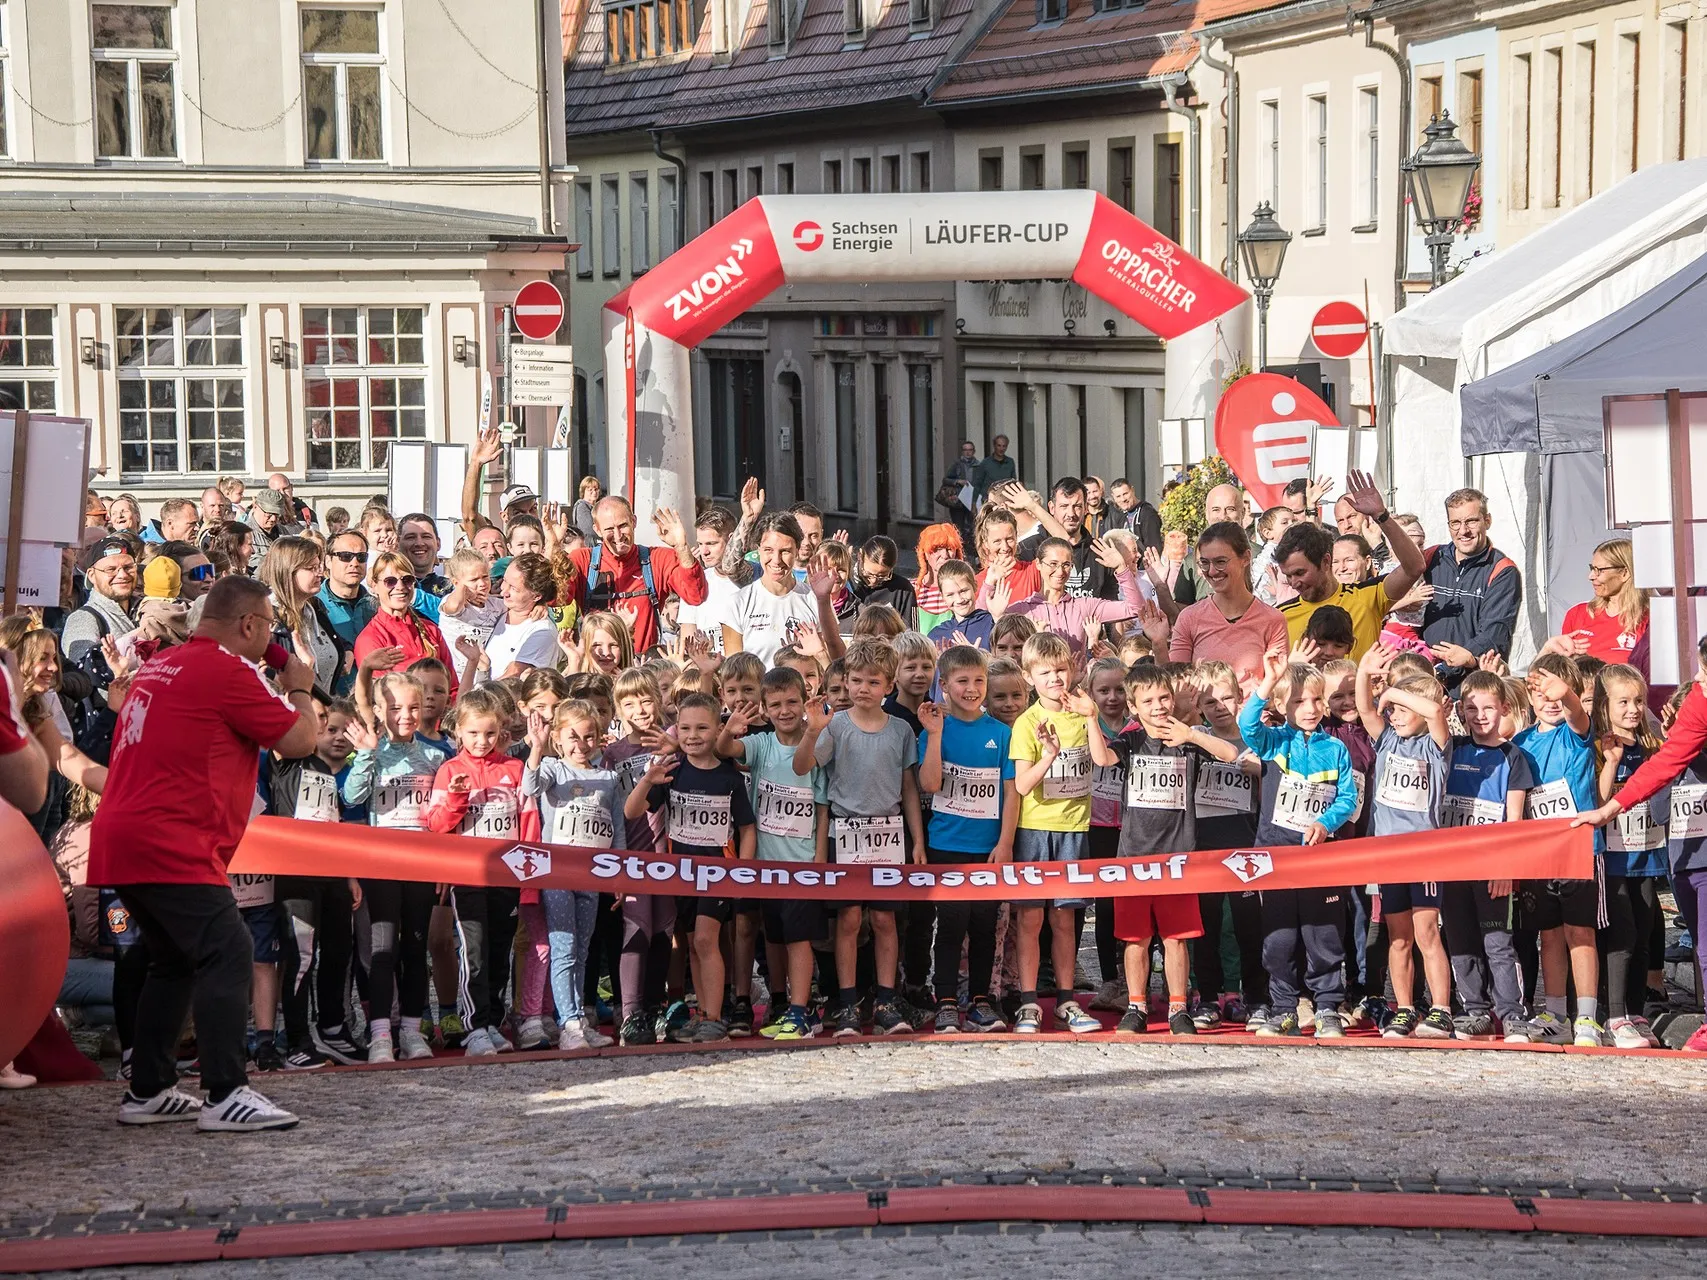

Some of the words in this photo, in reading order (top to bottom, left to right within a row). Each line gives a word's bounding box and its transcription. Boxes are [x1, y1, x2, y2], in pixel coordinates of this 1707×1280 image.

[832, 221, 898, 235] Sachsen
[925, 219, 1069, 245] LÄUFER-CUP
[832, 237, 893, 253] Energie
[1101, 239, 1197, 313] OPPACHER
[663, 256, 744, 321] ZVON
[1107, 266, 1174, 313] MINERALQUELLEN
[701, 294, 724, 312] bewegen
[723, 288, 732, 297] die
[988, 284, 1030, 318] Konditorei
[520, 349, 544, 357] Burganlage
[528, 364, 554, 372] Information
[528, 394, 552, 402] Obermarkt
[1149, 773, 1184, 788] 1090
[1215, 770, 1251, 790] 1028
[1393, 772, 1428, 790] 1046
[302, 786, 310, 801] 1
[378, 790, 386, 805] 1
[406, 790, 432, 805] 104
[960, 783, 996, 798] 1080
[775, 800, 813, 817] 1023
[1280, 791, 1288, 806] 1
[1304, 798, 1331, 815] 108
[1530, 797, 1569, 818] 1079
[484, 814, 517, 832] 1031
[690, 810, 728, 826] 1038
[583, 819, 614, 838] 1029
[839, 834, 846, 848] 1
[864, 832, 900, 847] 1074
[591, 853, 847, 891] Stolpener
[871, 854, 1188, 887] Basalt-Lauf
[1422, 881, 1437, 897] 10
[1325, 895, 1340, 903] JAKO
